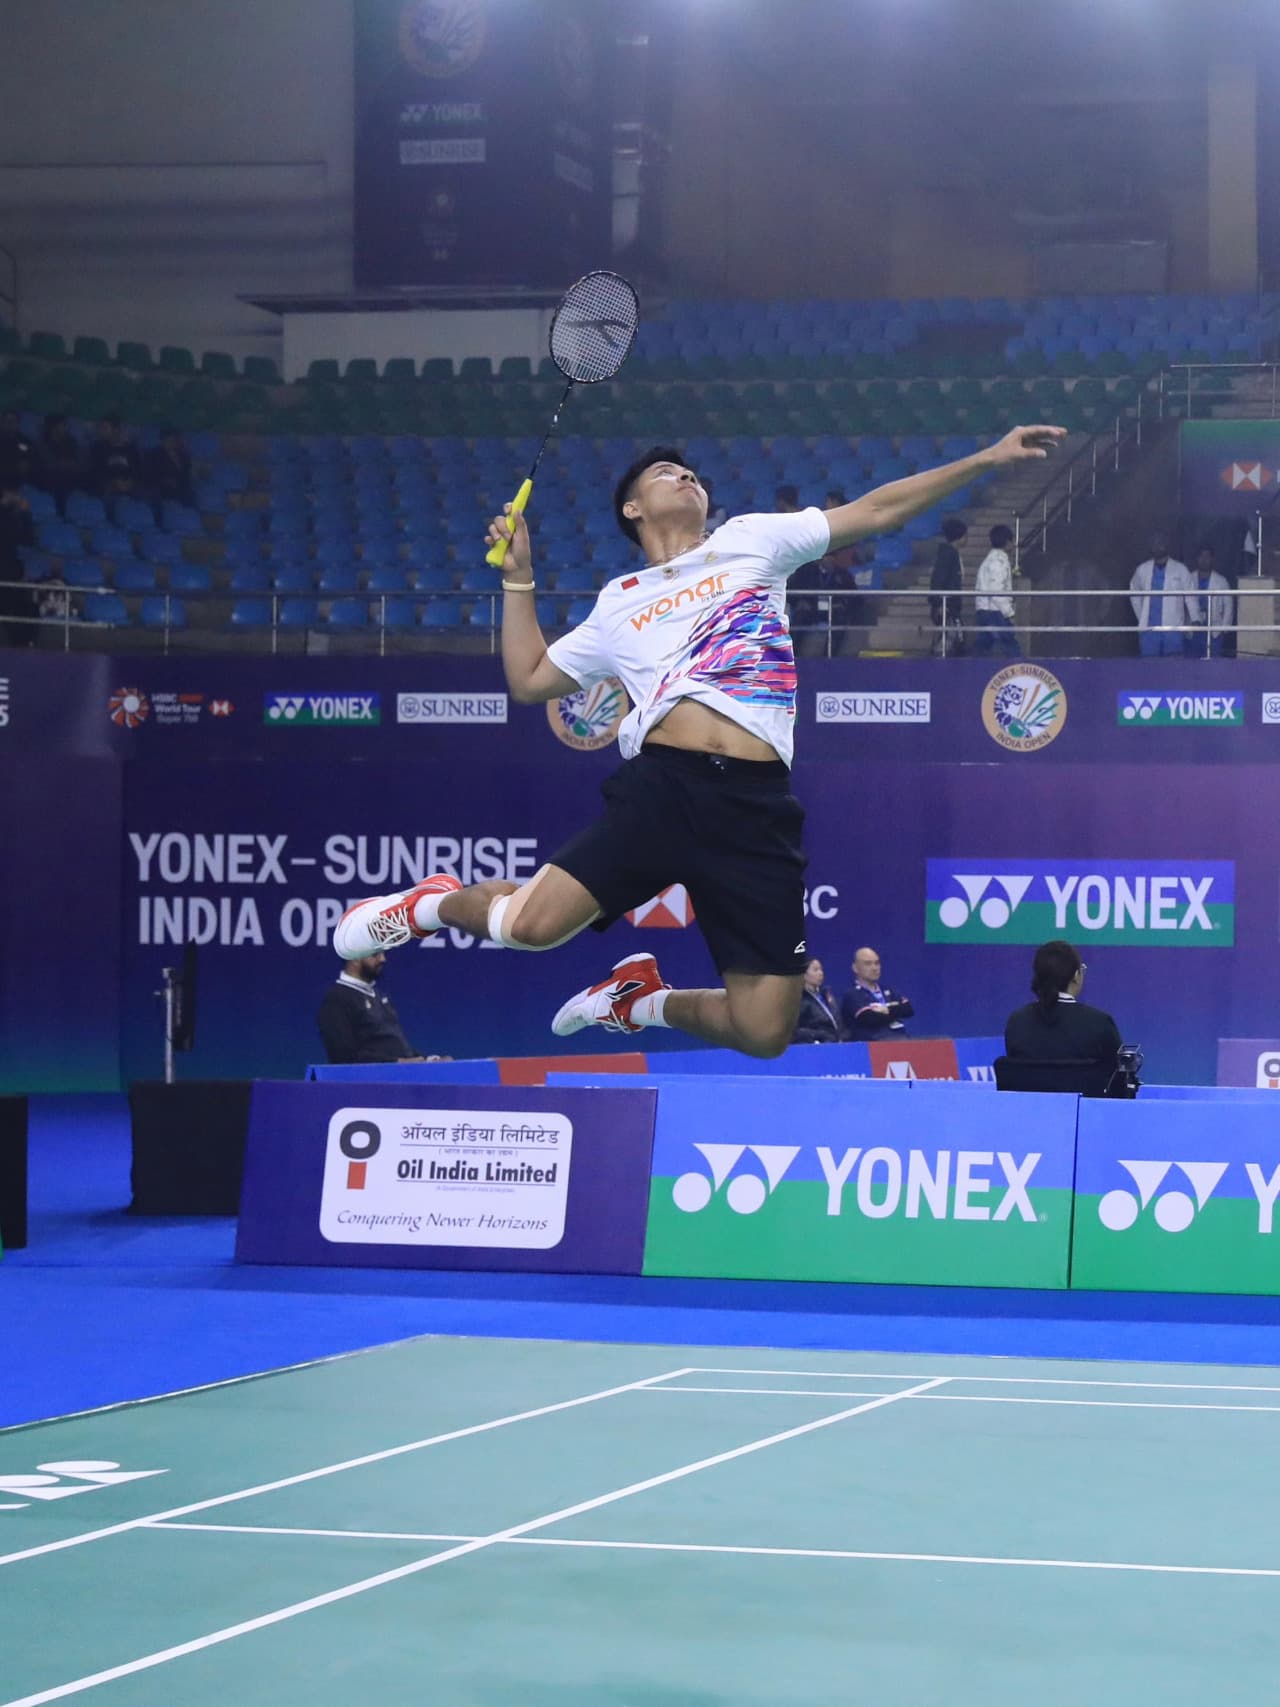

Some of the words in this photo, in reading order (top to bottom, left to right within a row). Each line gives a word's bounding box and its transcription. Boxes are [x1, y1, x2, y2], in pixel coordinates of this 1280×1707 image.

[309, 697, 373, 719] YONEX
[421, 697, 504, 718] SUNRISE
[841, 698, 928, 716] SUNRISE
[1166, 696, 1236, 720] YONEX
[1044, 875, 1214, 930] YONEX
[139, 897, 264, 946] INDIA
[451, 1123, 496, 1144] इंडिया
[500, 1124, 560, 1144] लिमिटेड
[397, 1159, 423, 1179] Oil
[429, 1160, 479, 1181] India
[485, 1161, 558, 1183] Limited
[816, 1146, 1042, 1222] YONEX
[336, 1209, 422, 1233] Conquering
[426, 1213, 475, 1228] Newer
[478, 1214, 549, 1231] Horizons
